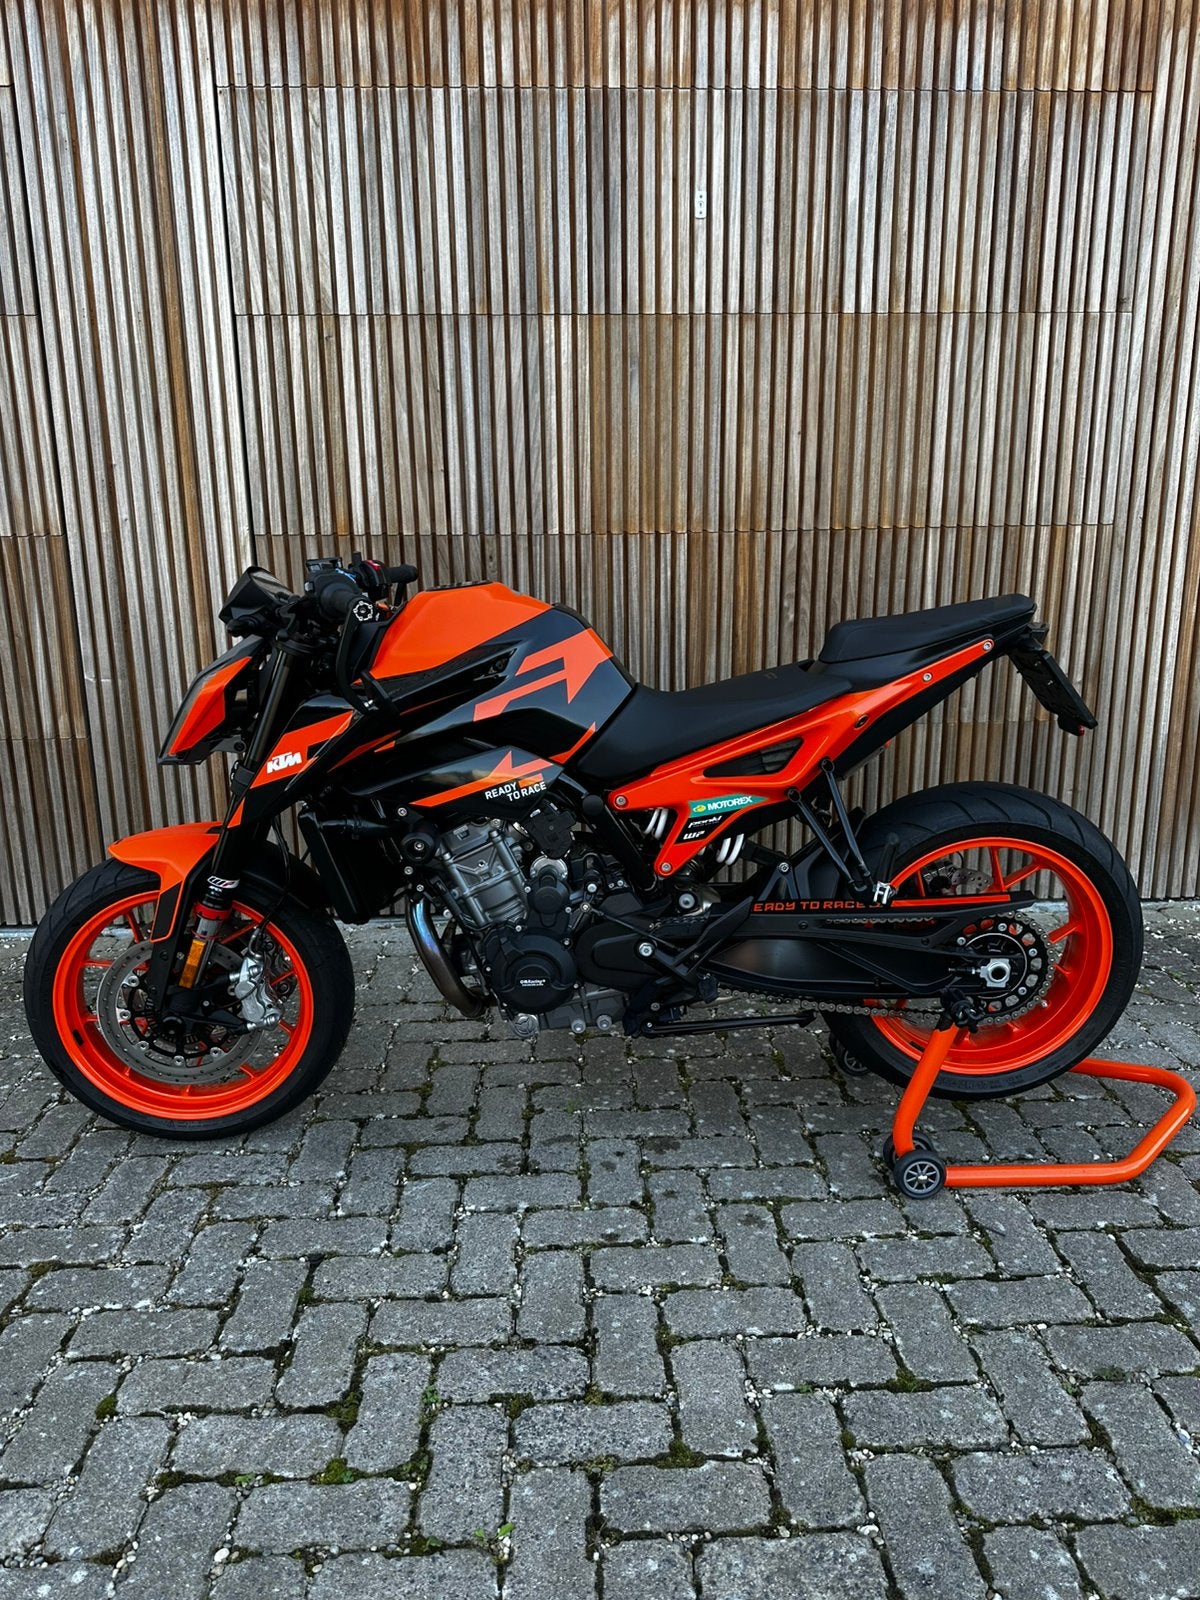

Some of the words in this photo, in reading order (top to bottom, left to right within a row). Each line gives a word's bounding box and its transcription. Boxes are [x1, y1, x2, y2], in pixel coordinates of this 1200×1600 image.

[267, 752, 302, 774] KTM
[485, 782, 517, 800] READY
[507, 791, 521, 802] TO
[521, 782, 547, 797] RACE
[707, 796, 753, 811] MOTOREX
[753, 901, 796, 912] EADY
[801, 901, 820, 910] TO
